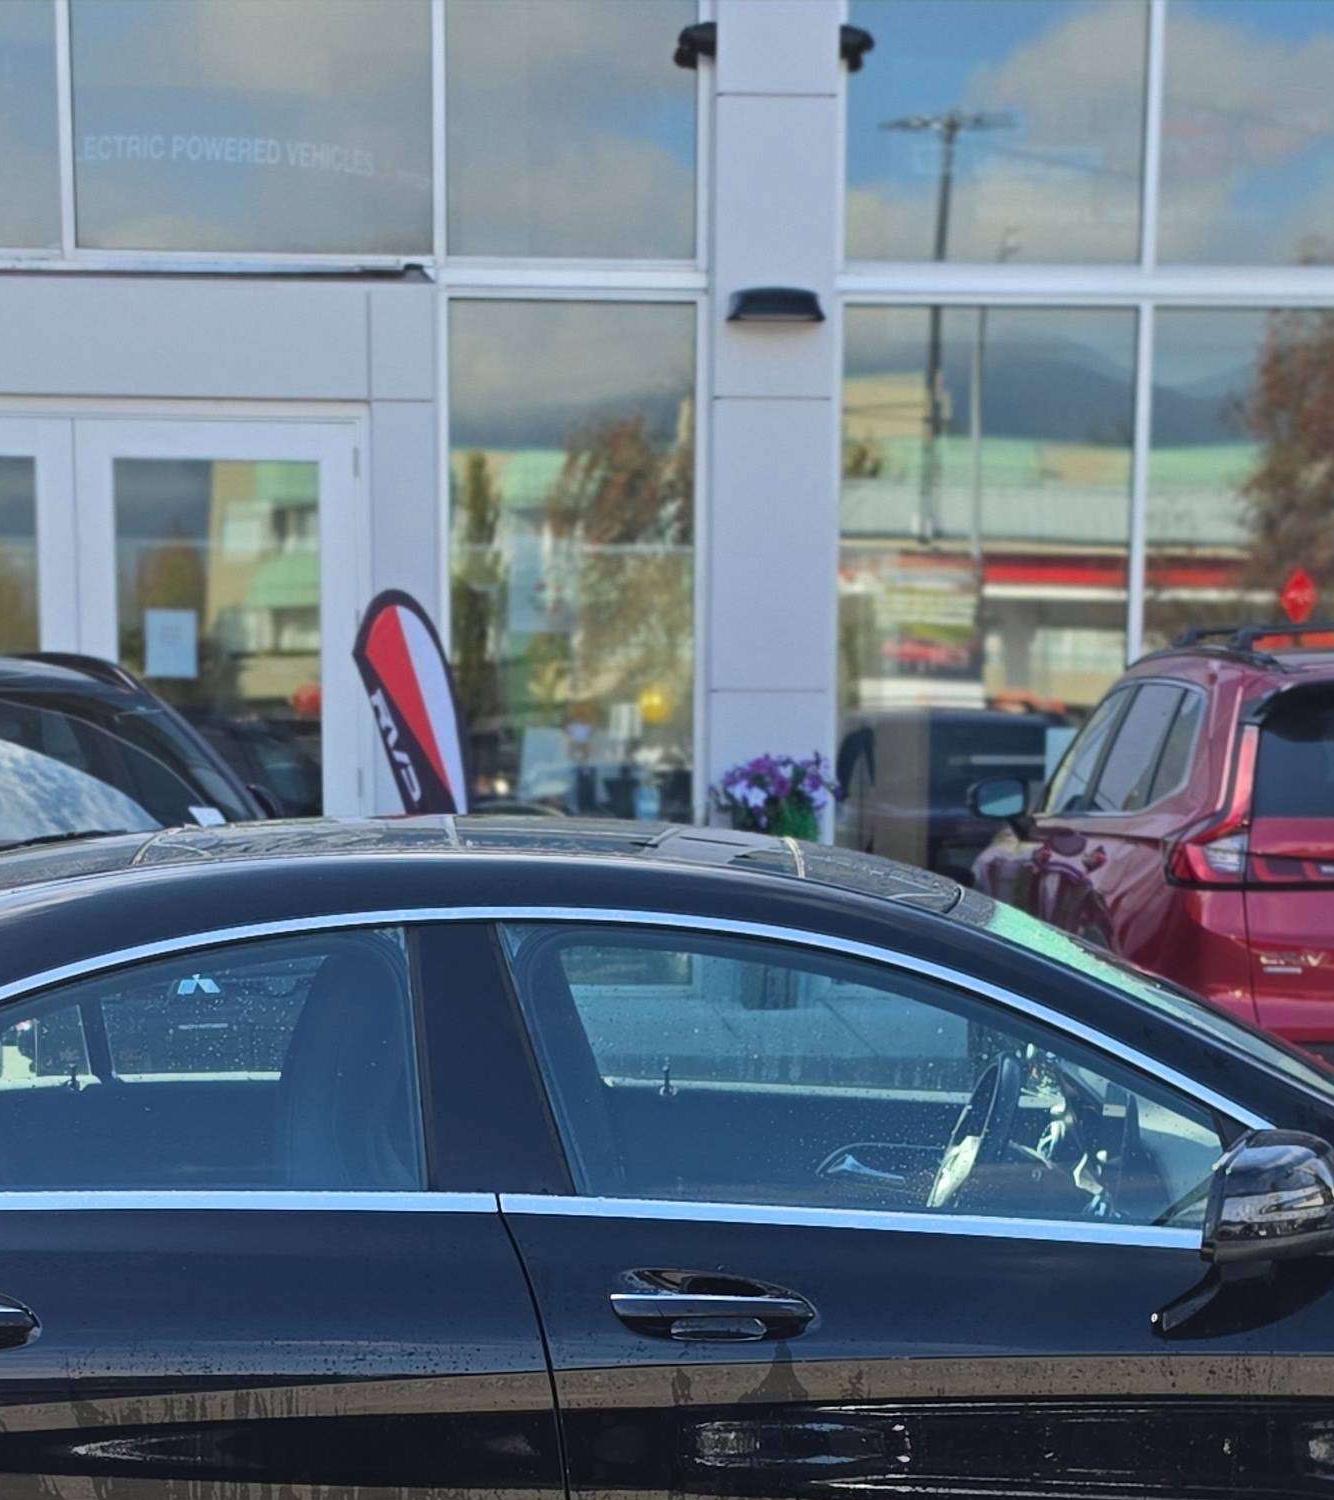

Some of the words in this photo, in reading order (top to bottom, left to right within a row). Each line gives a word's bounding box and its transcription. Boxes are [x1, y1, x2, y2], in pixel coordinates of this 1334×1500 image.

[75, 134, 165, 161] ECTRIC
[171, 136, 280, 165] POWERED
[286, 142, 374, 176] VEHICLES
